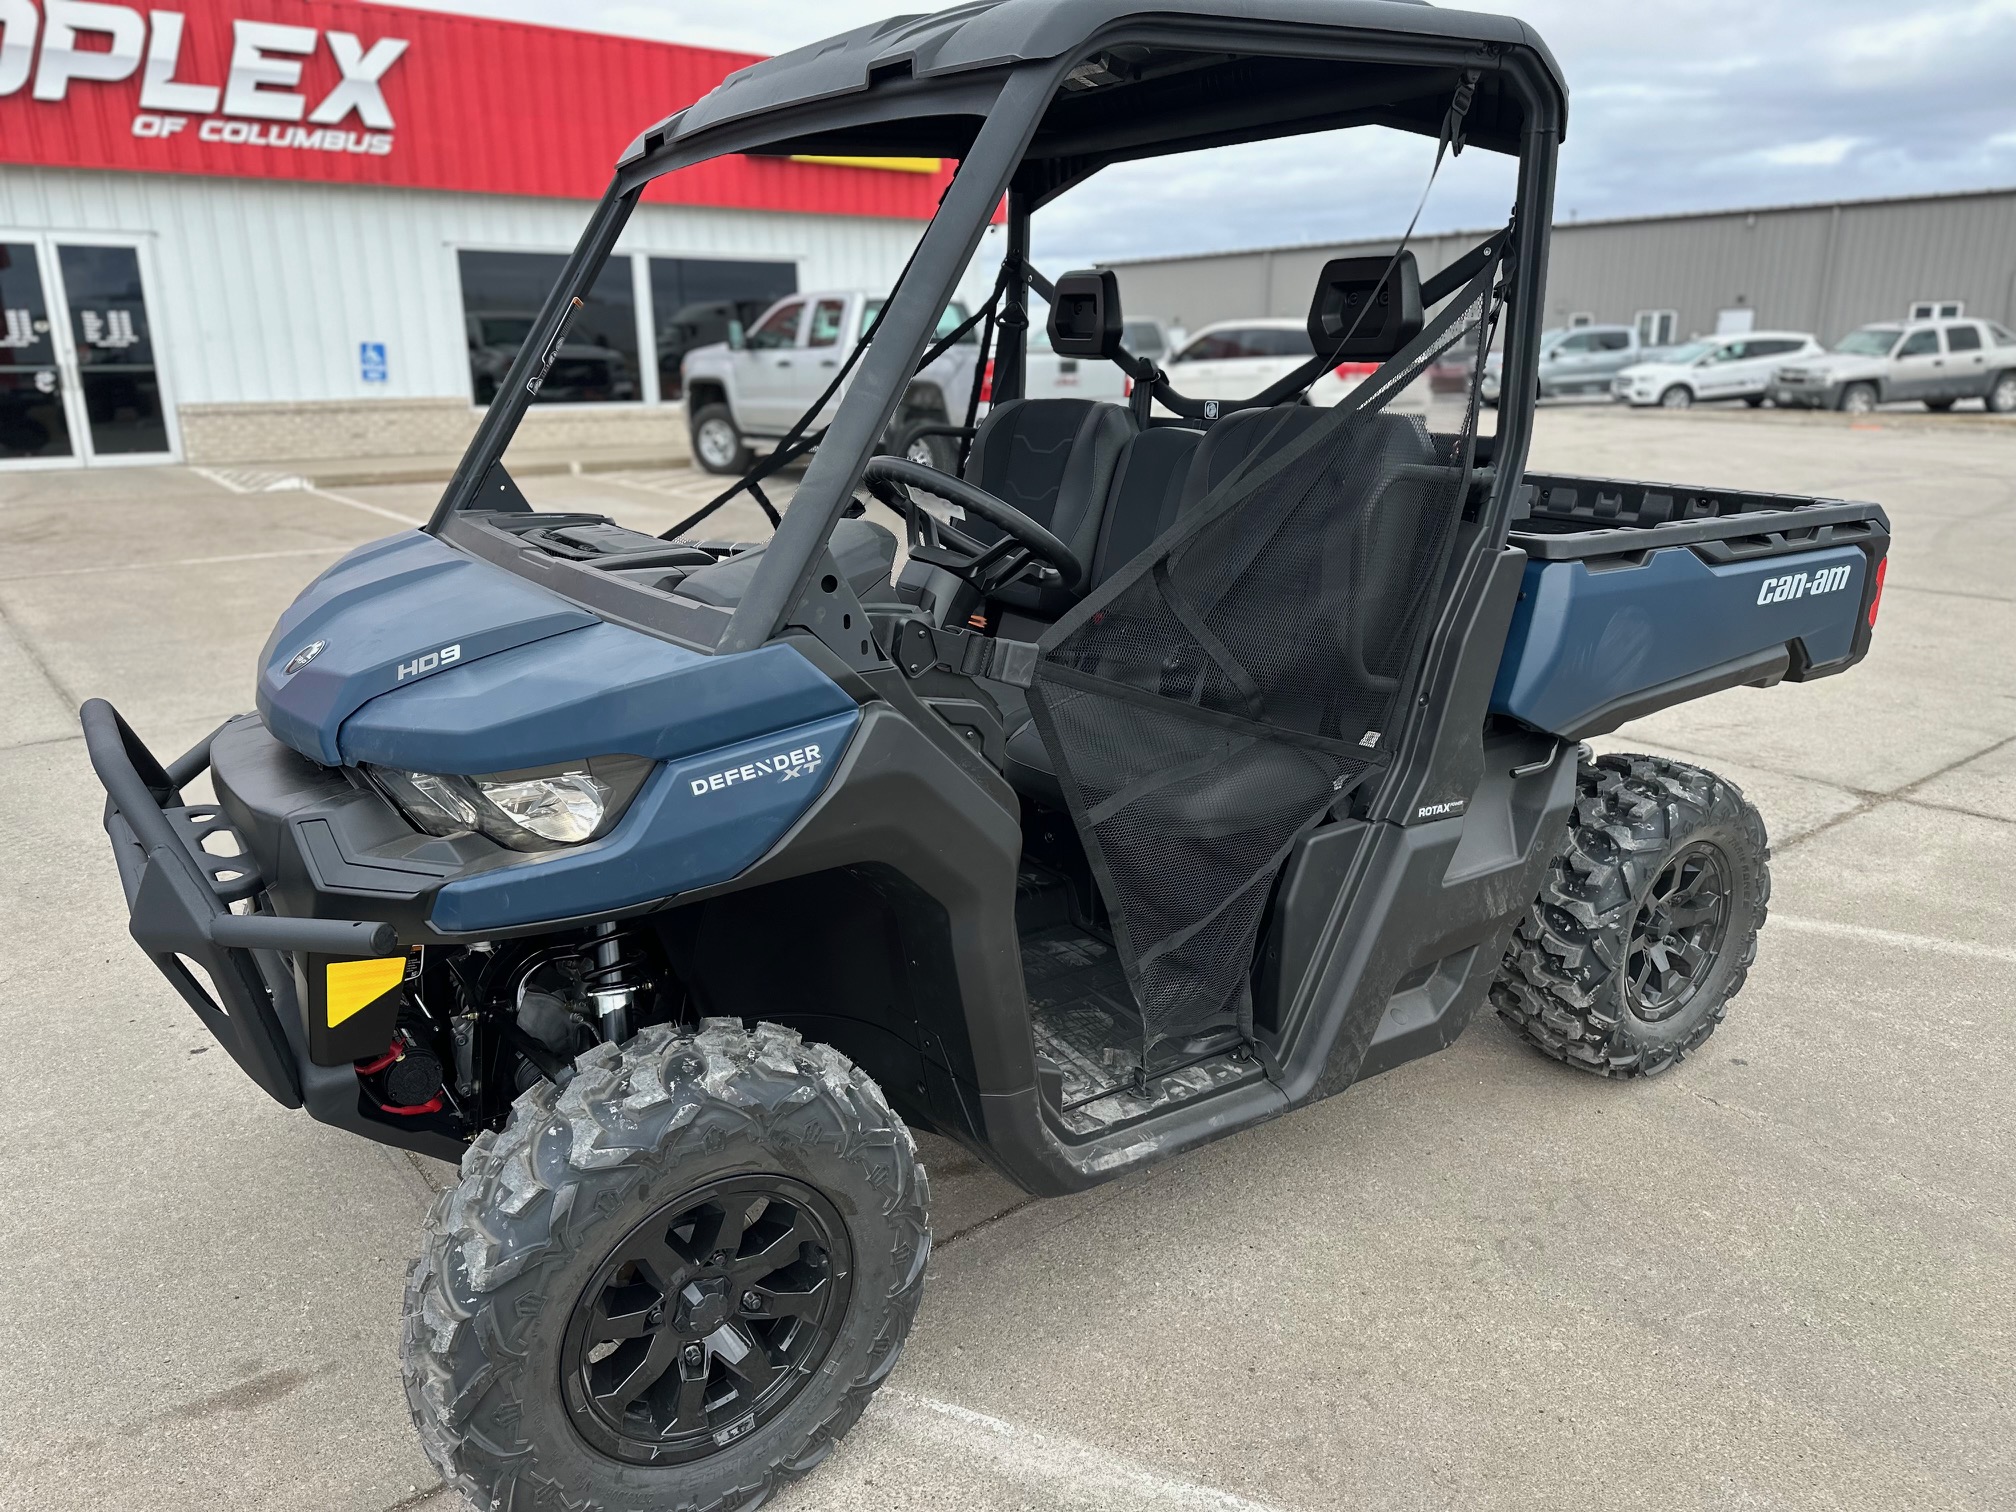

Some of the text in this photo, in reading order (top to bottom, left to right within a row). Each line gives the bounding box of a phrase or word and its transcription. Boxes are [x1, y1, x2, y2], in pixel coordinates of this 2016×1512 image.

[132, 114, 393, 156] OF COLUMBUS
[1757, 565, 1851, 605] can-am
[397, 644, 460, 681] HD9
[690, 744, 821, 796] DEFENDER
[782, 759, 822, 782] XT
[1418, 802, 1451, 818] ROTAX
